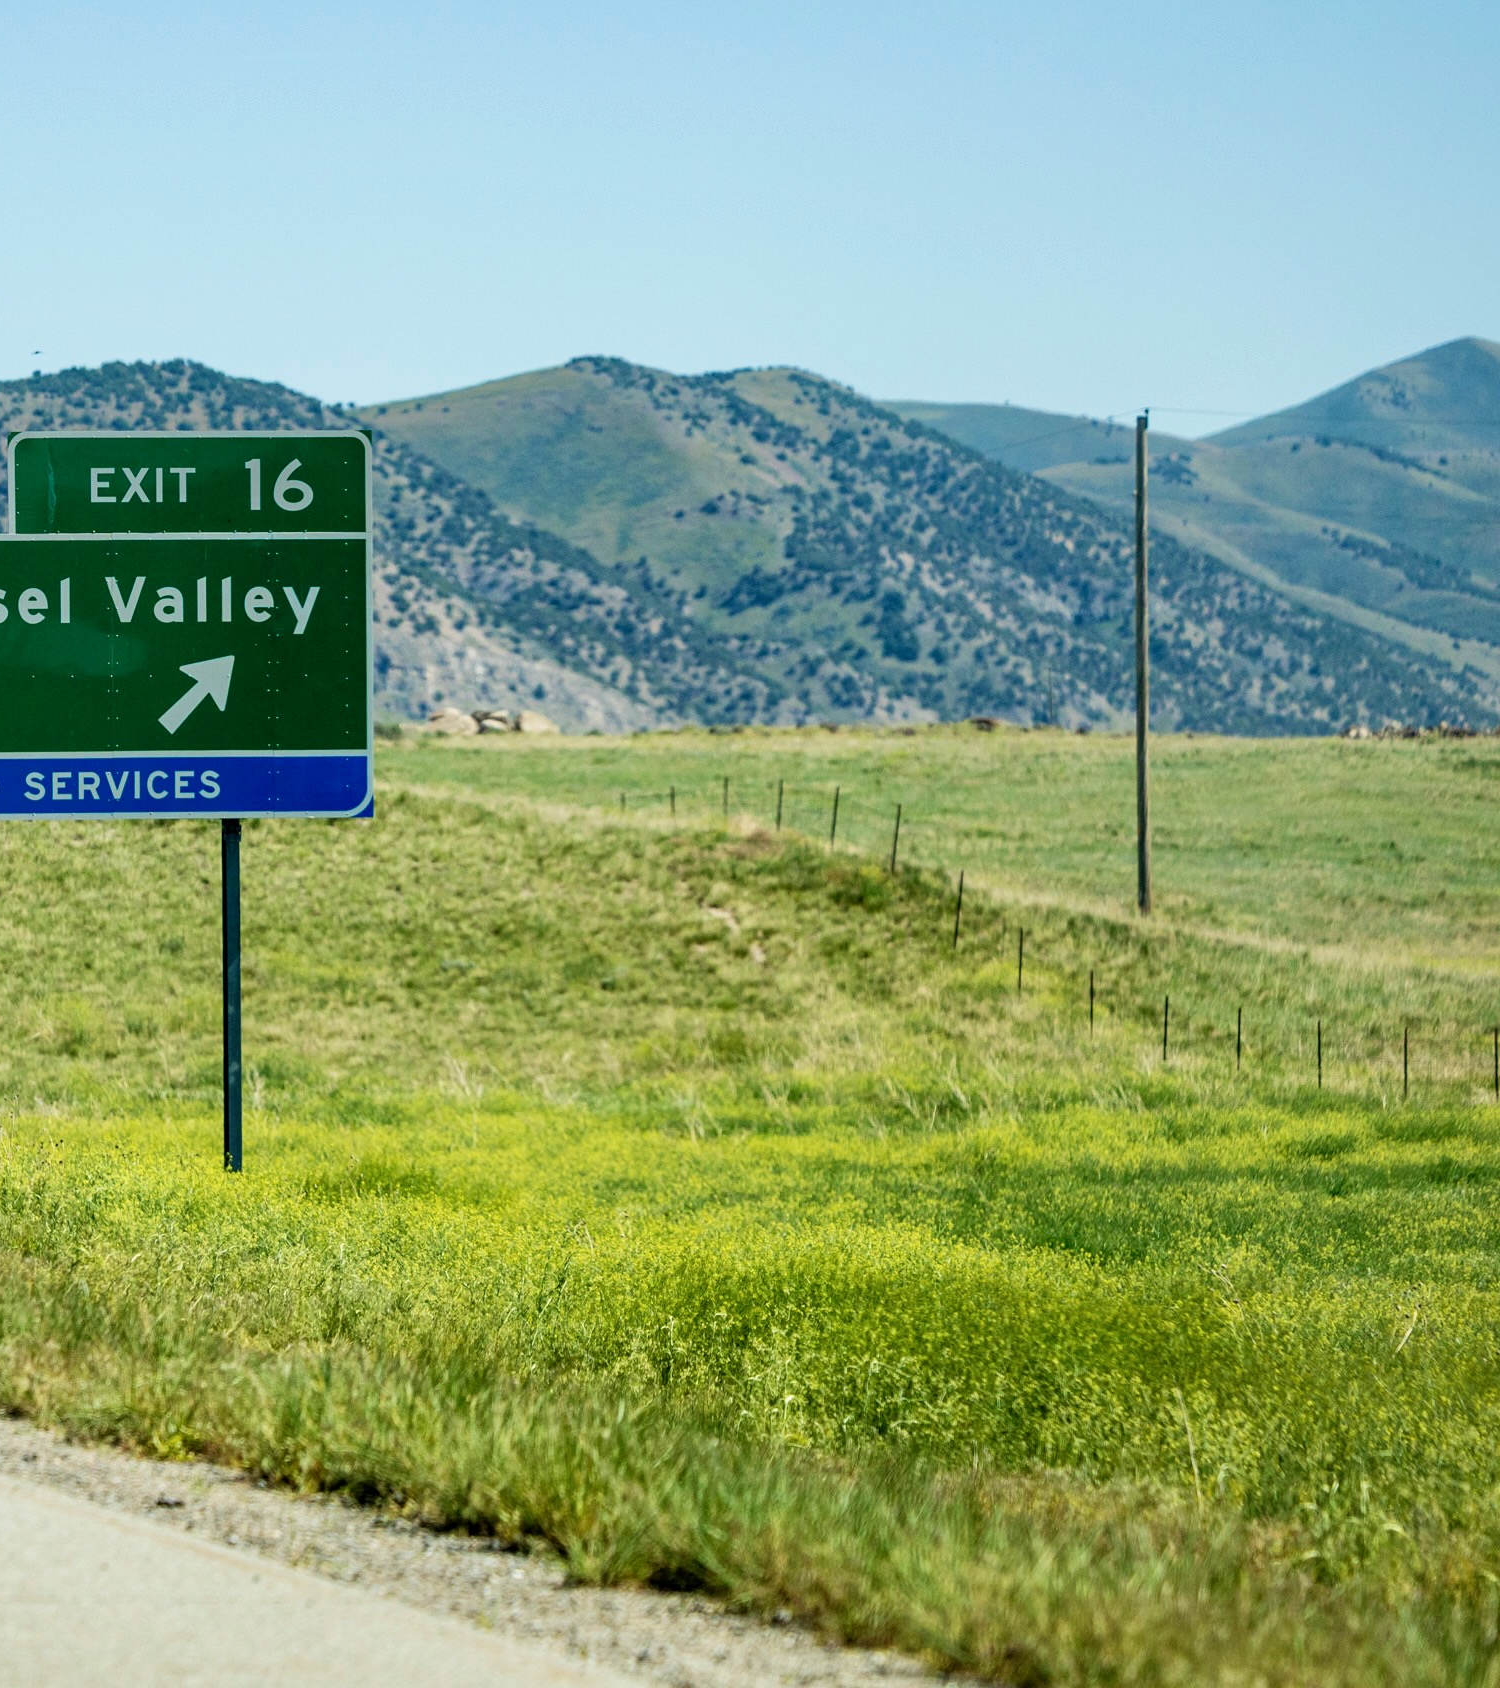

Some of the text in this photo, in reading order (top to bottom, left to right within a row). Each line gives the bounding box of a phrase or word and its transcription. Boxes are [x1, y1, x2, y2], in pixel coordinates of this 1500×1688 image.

[90, 458, 314, 512] EXIT 16
[105, 576, 320, 635] Valley
[24, 770, 221, 801] SERVICES
